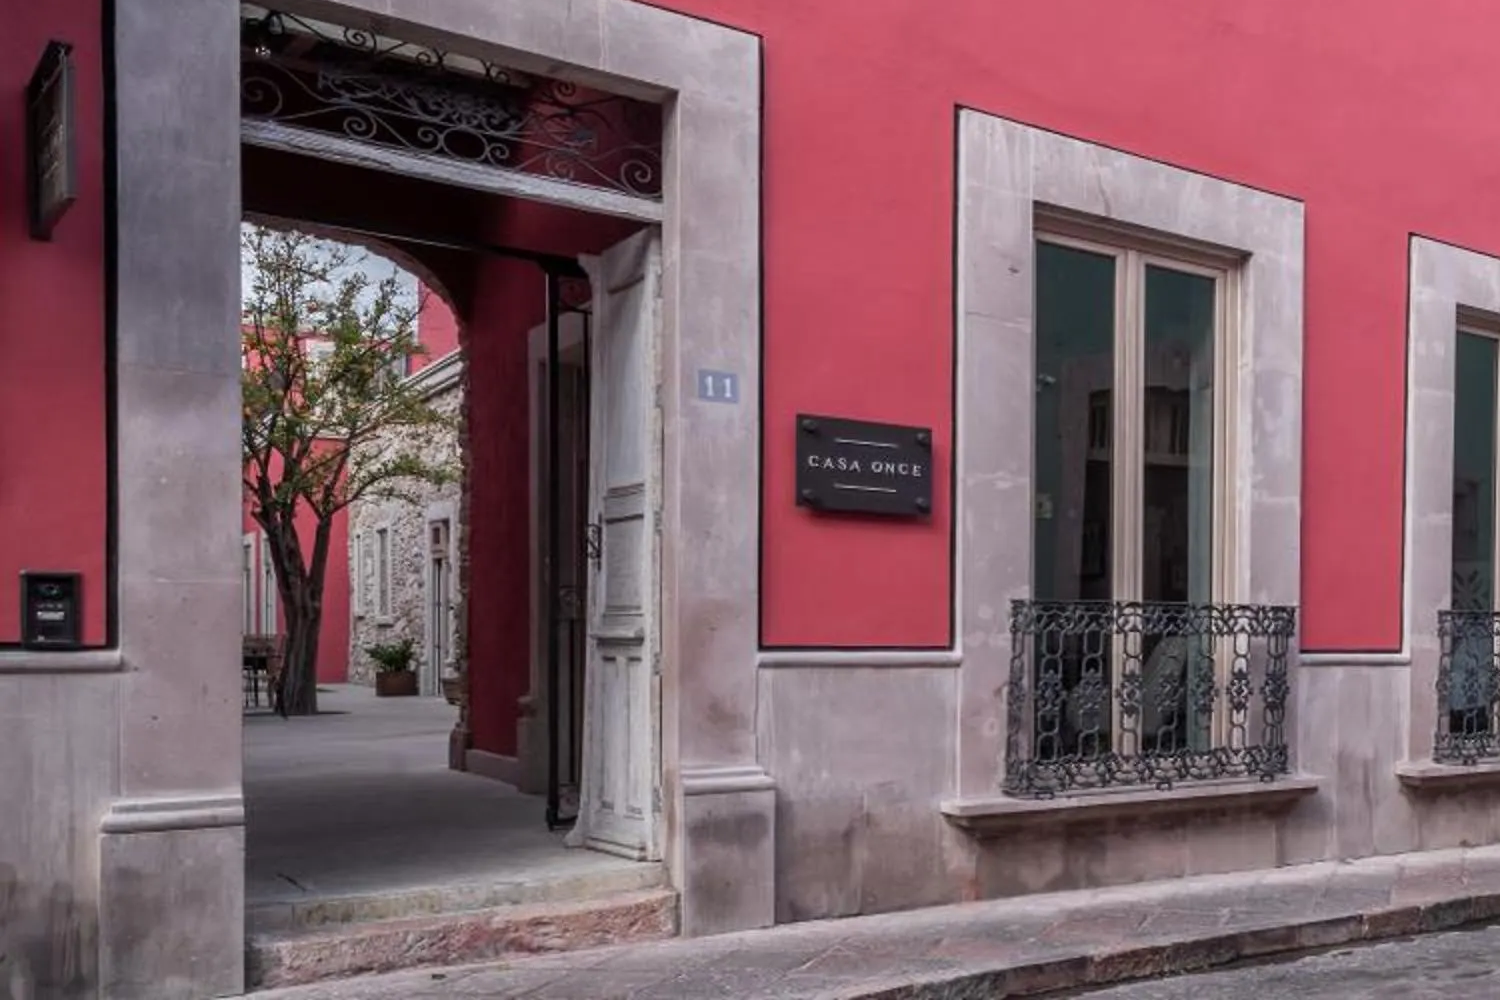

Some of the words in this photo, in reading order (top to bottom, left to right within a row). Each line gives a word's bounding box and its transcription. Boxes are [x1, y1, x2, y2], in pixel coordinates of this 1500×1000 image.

[704, 375, 733, 398] 11
[807, 454, 861, 473] CASA
[871, 460, 922, 477] ONCE
